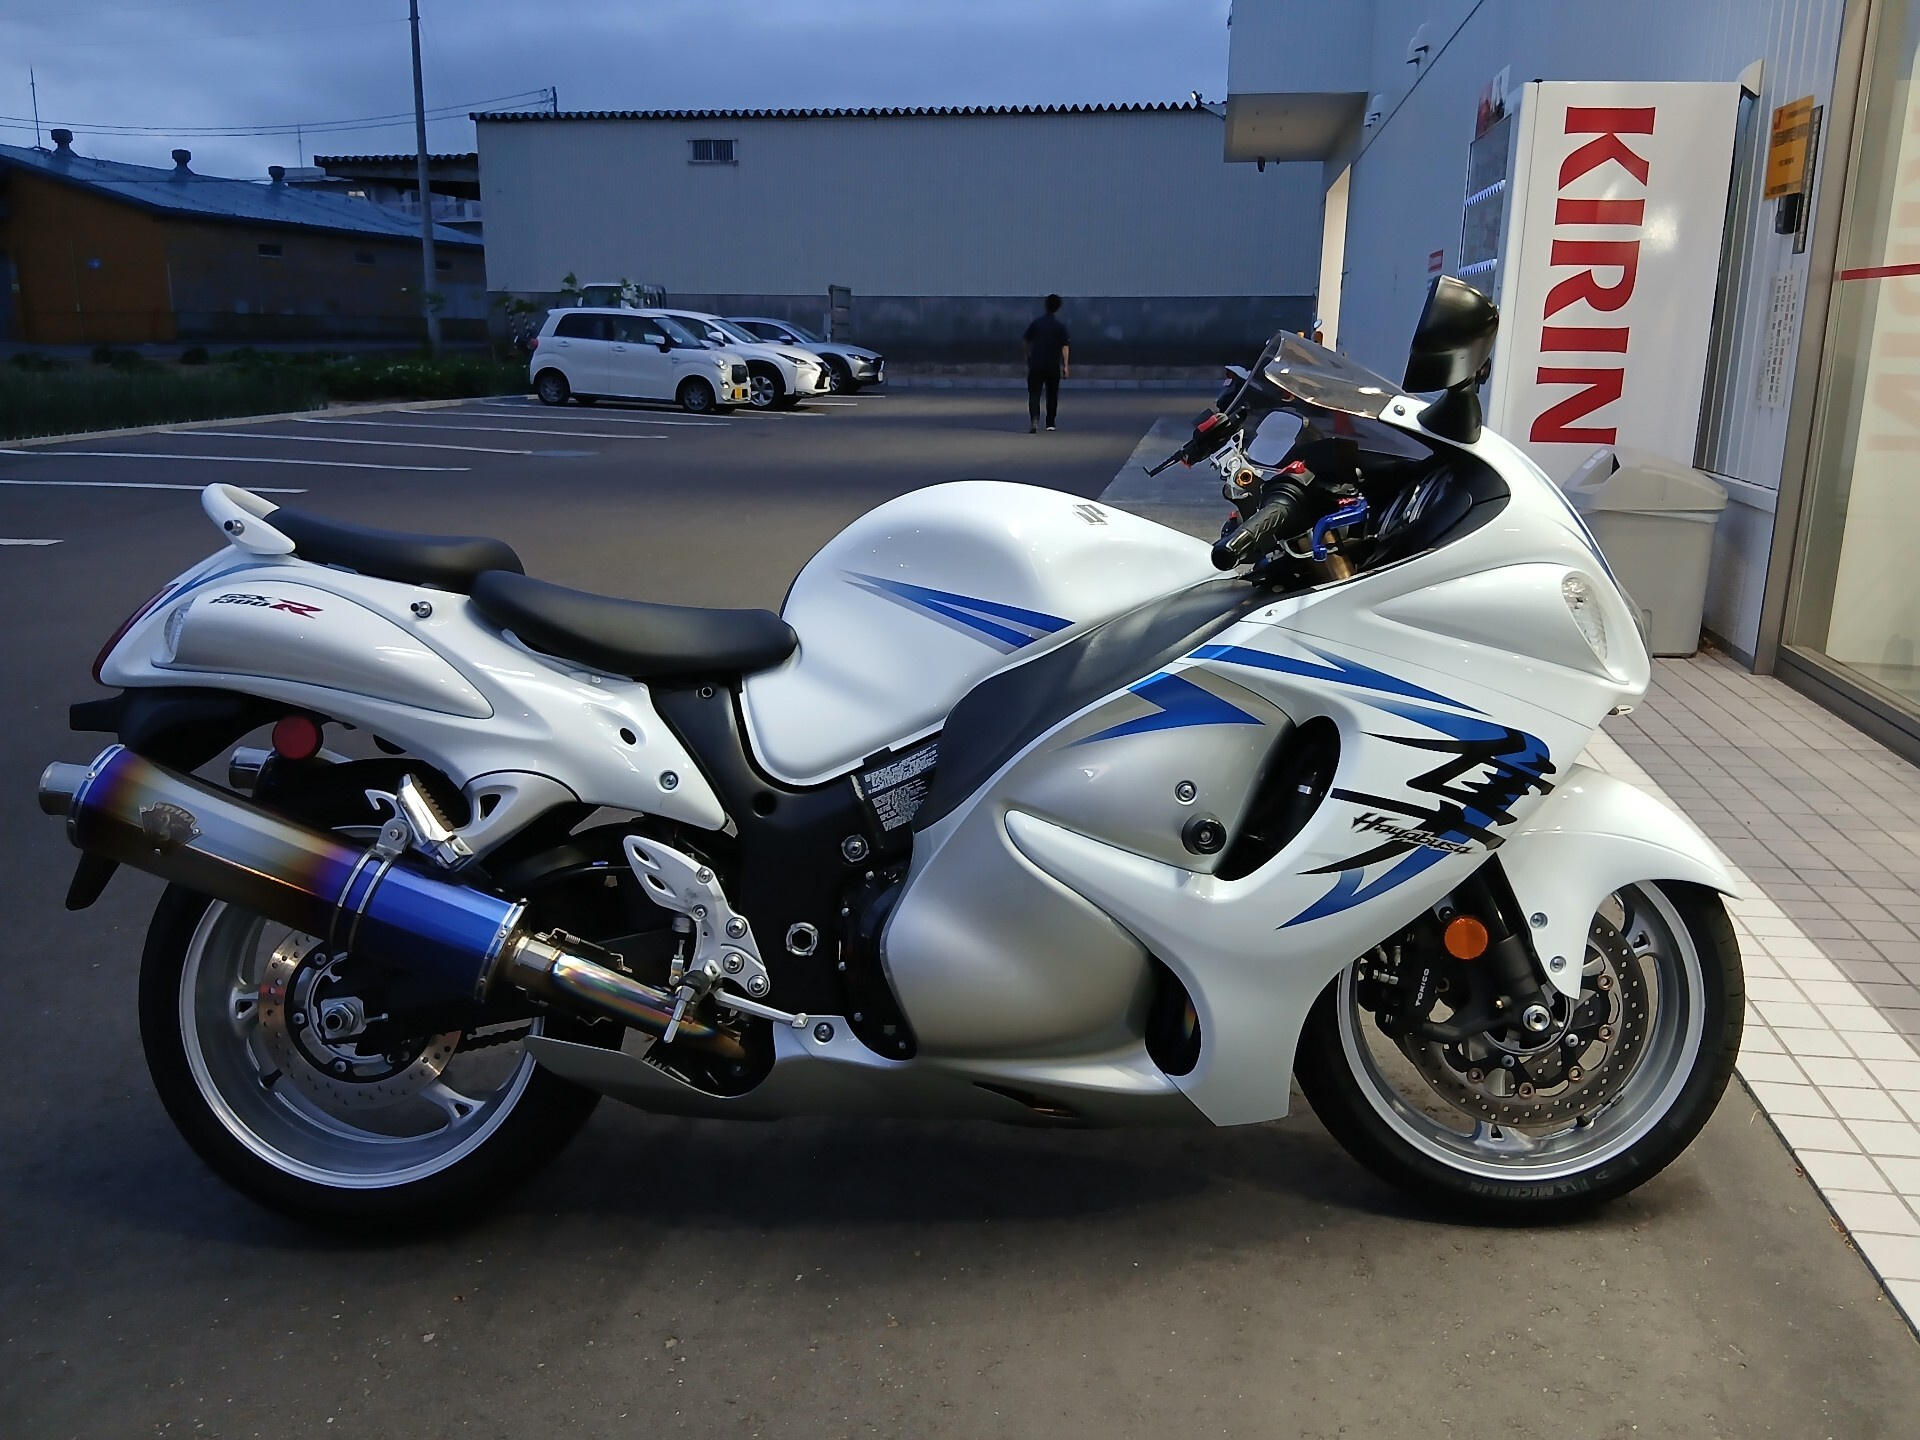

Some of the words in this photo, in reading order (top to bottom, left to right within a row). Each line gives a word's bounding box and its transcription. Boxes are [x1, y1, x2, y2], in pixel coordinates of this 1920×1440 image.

[1529, 106, 1656, 445] KIRIN
[1351, 812, 1475, 855] Hayabusa
[1414, 968, 1430, 1007] TOKICO
[1468, 1182, 1556, 1198] MICHELIN
